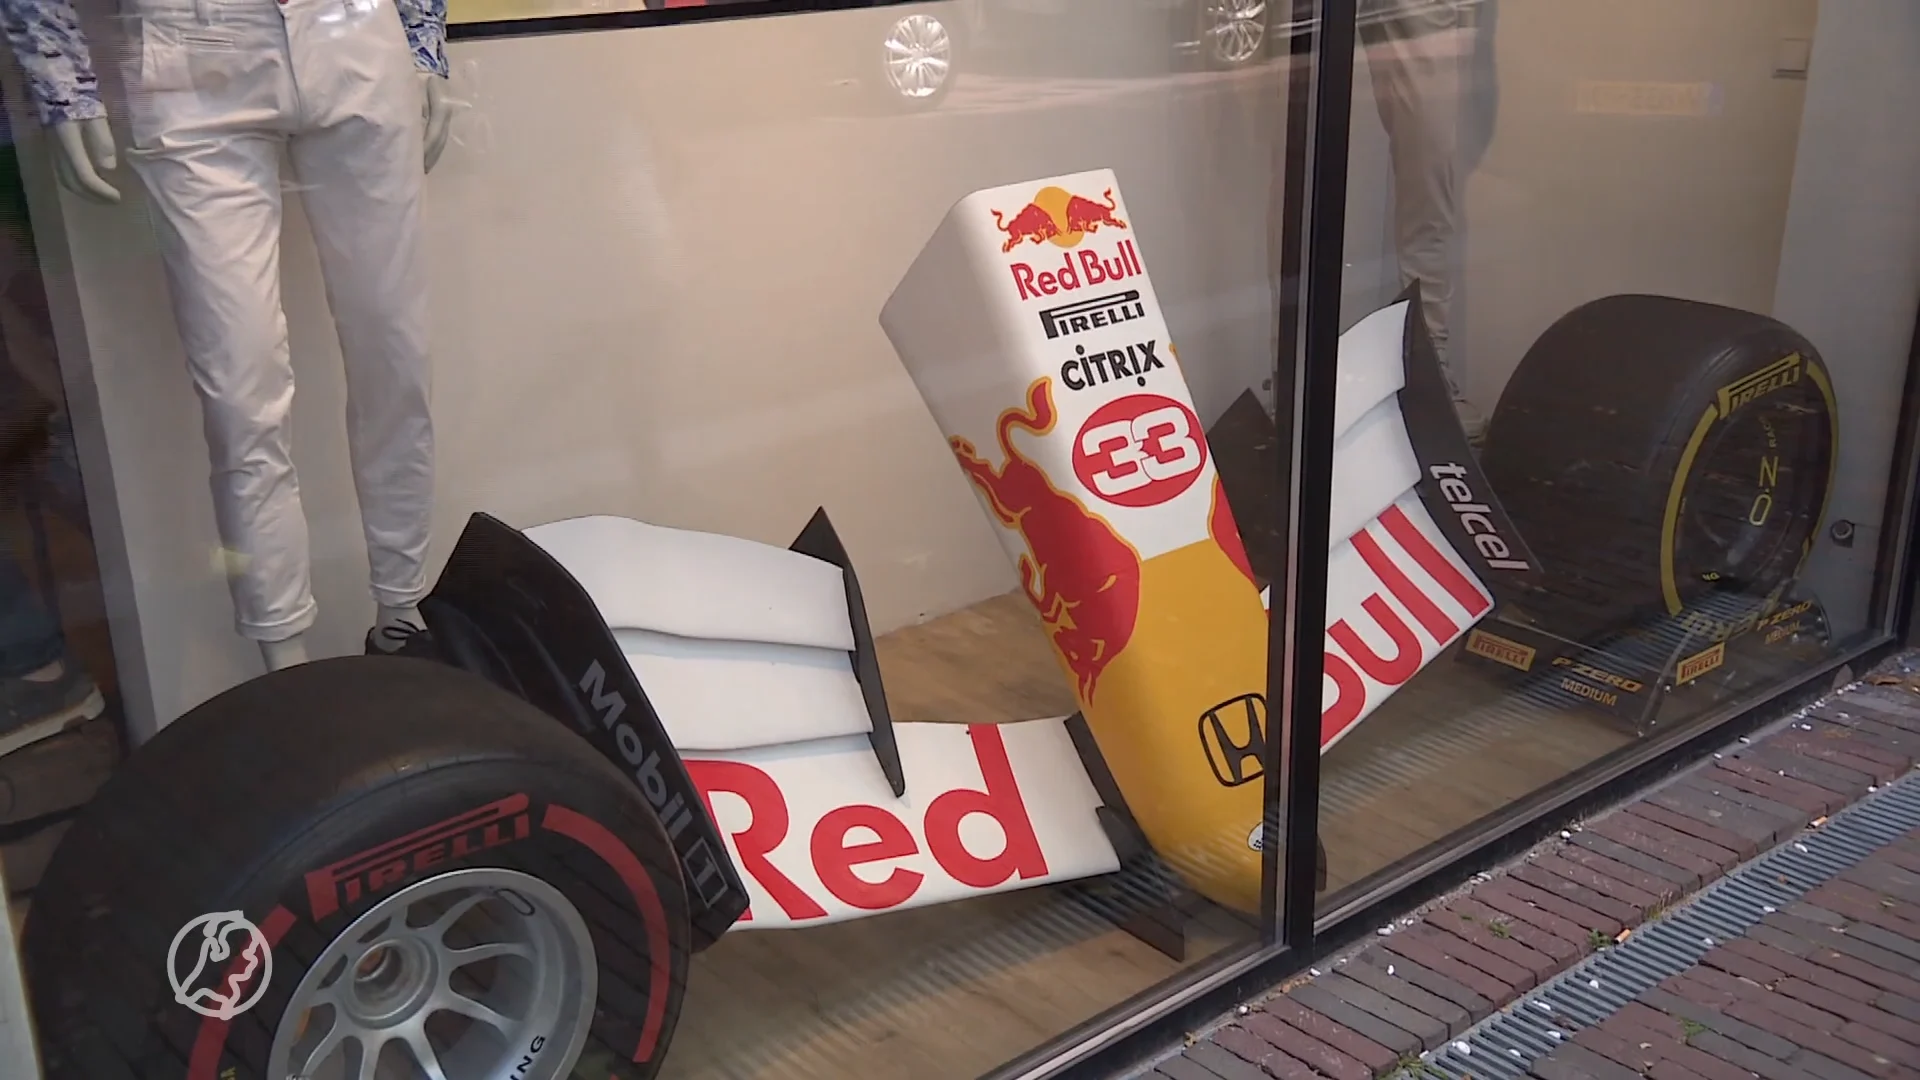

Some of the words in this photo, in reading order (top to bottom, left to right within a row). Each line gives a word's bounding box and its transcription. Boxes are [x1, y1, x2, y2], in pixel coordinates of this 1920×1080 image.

[1010, 252, 1081, 301] Red
[1078, 239, 1143, 284] Bull
[1039, 290, 1146, 340] PIRELLI
[1716, 352, 1801, 421] PIRELLI
[1081, 405, 1202, 497] 33
[1429, 462, 1531, 571] telcel
[1473, 635, 1529, 666] PIRELLI
[1681, 648, 1721, 679] PIRELLI
[1561, 677, 1618, 707] MEDIUM
[579, 659, 693, 841] Mobil
[682, 722, 1049, 921] Red
[304, 792, 530, 923] PIRELLI
